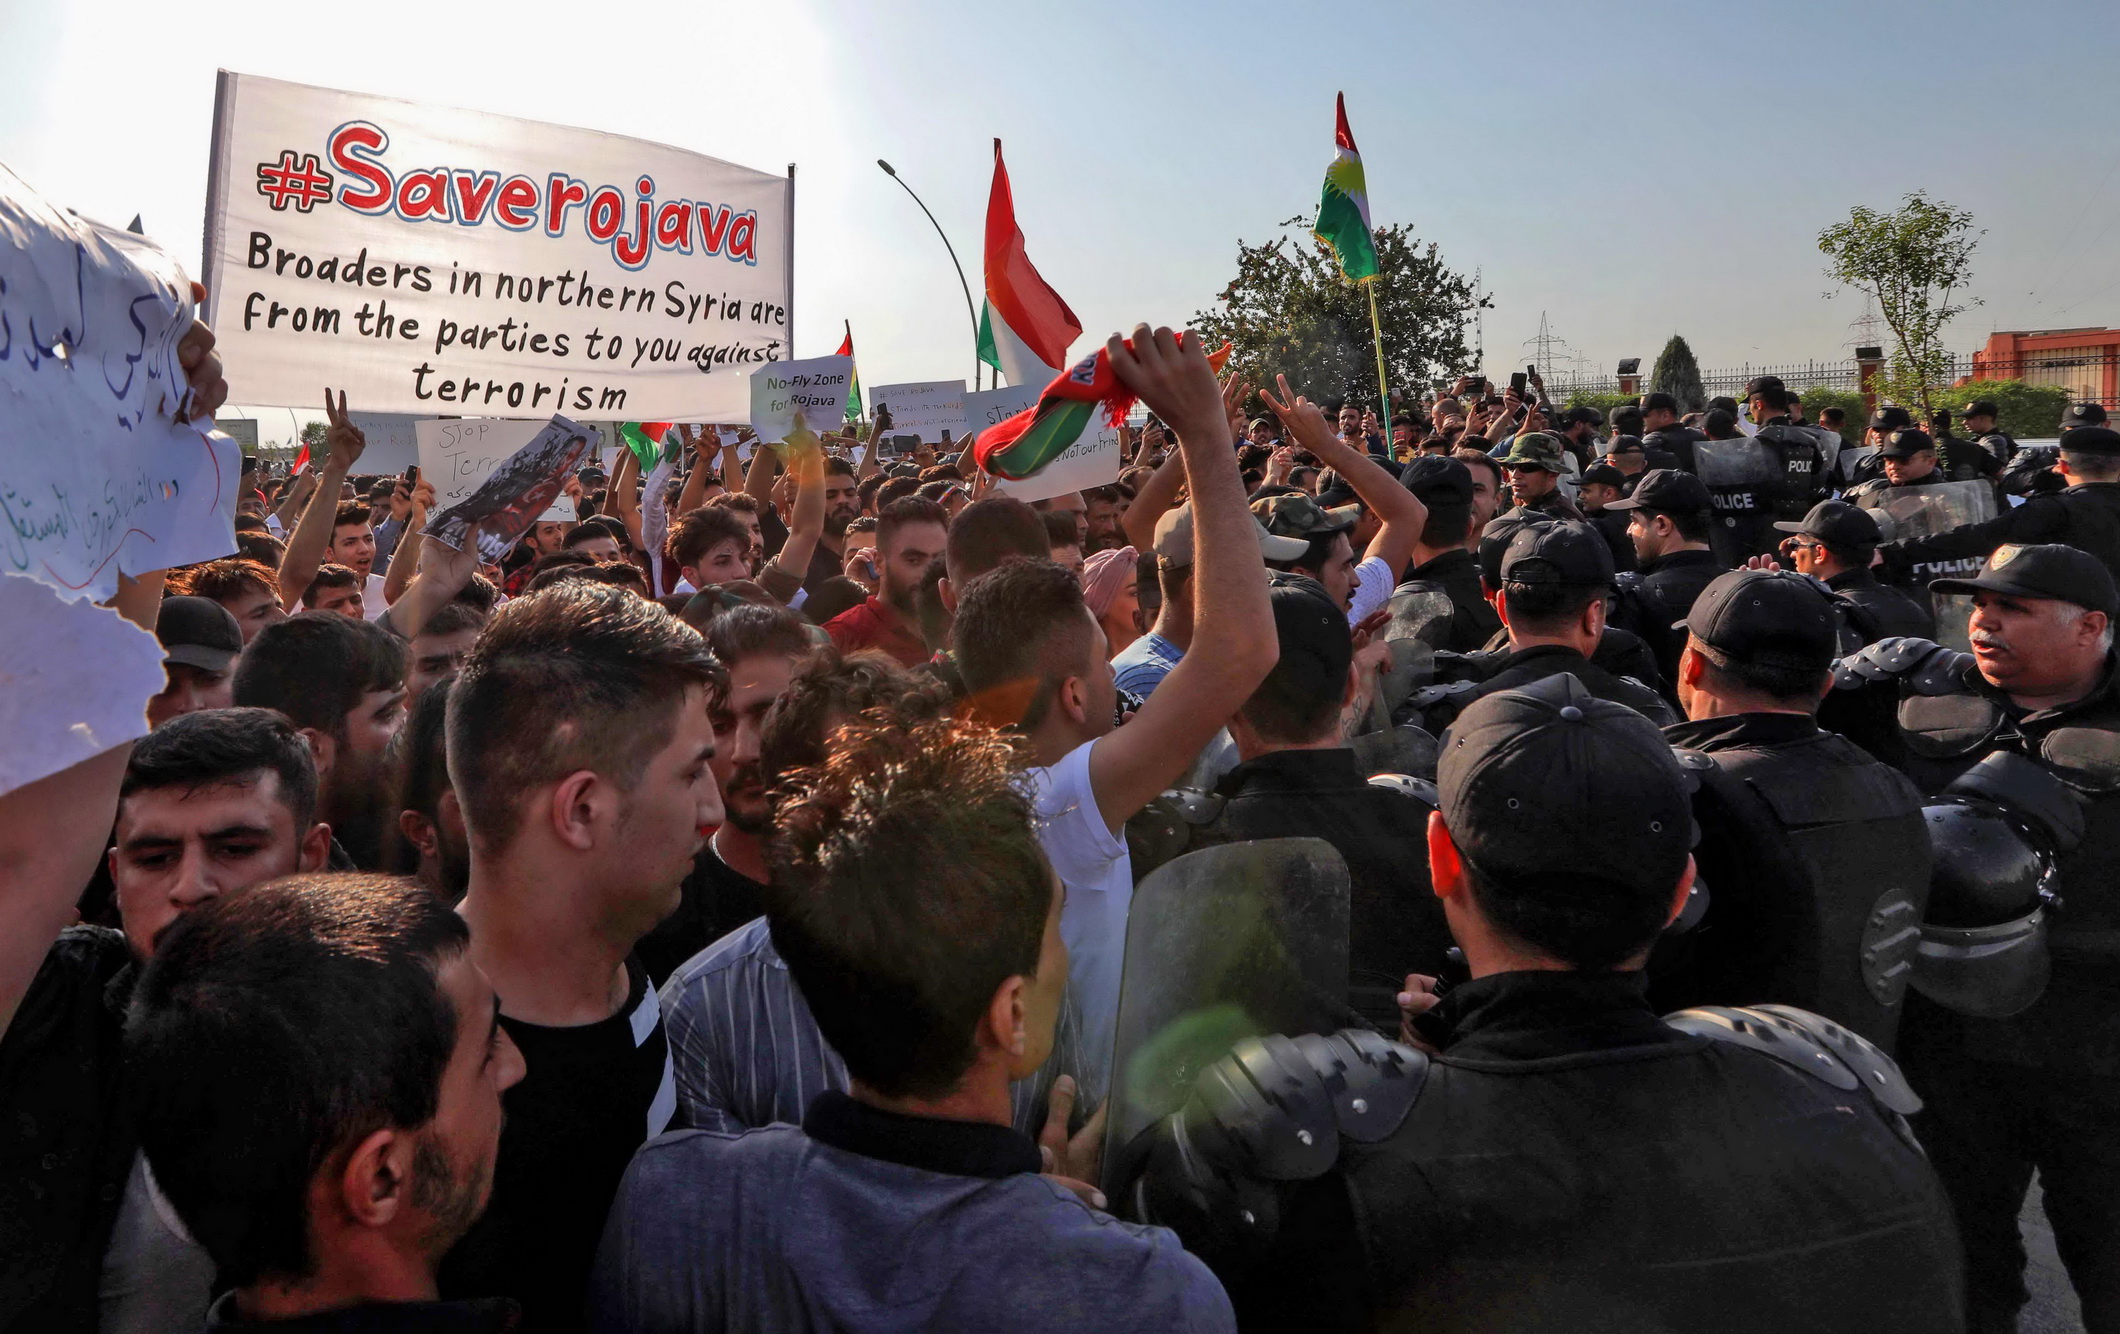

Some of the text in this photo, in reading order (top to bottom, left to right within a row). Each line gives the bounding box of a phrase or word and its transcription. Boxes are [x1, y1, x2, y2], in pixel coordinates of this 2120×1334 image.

[247, 231, 785, 326] Broaders in northern Syria are
[354, 299, 420, 340] the
[435, 316, 570, 355] parties
[584, 327, 623, 360] to
[631, 336, 682, 368] you
[687, 339, 780, 374] against
[412, 362, 627, 411] terrorism
[767, 373, 844, 390] No-Fly Zone
[770, 393, 836, 412] for Rojava
[1712, 492, 1755, 509] OLICE
